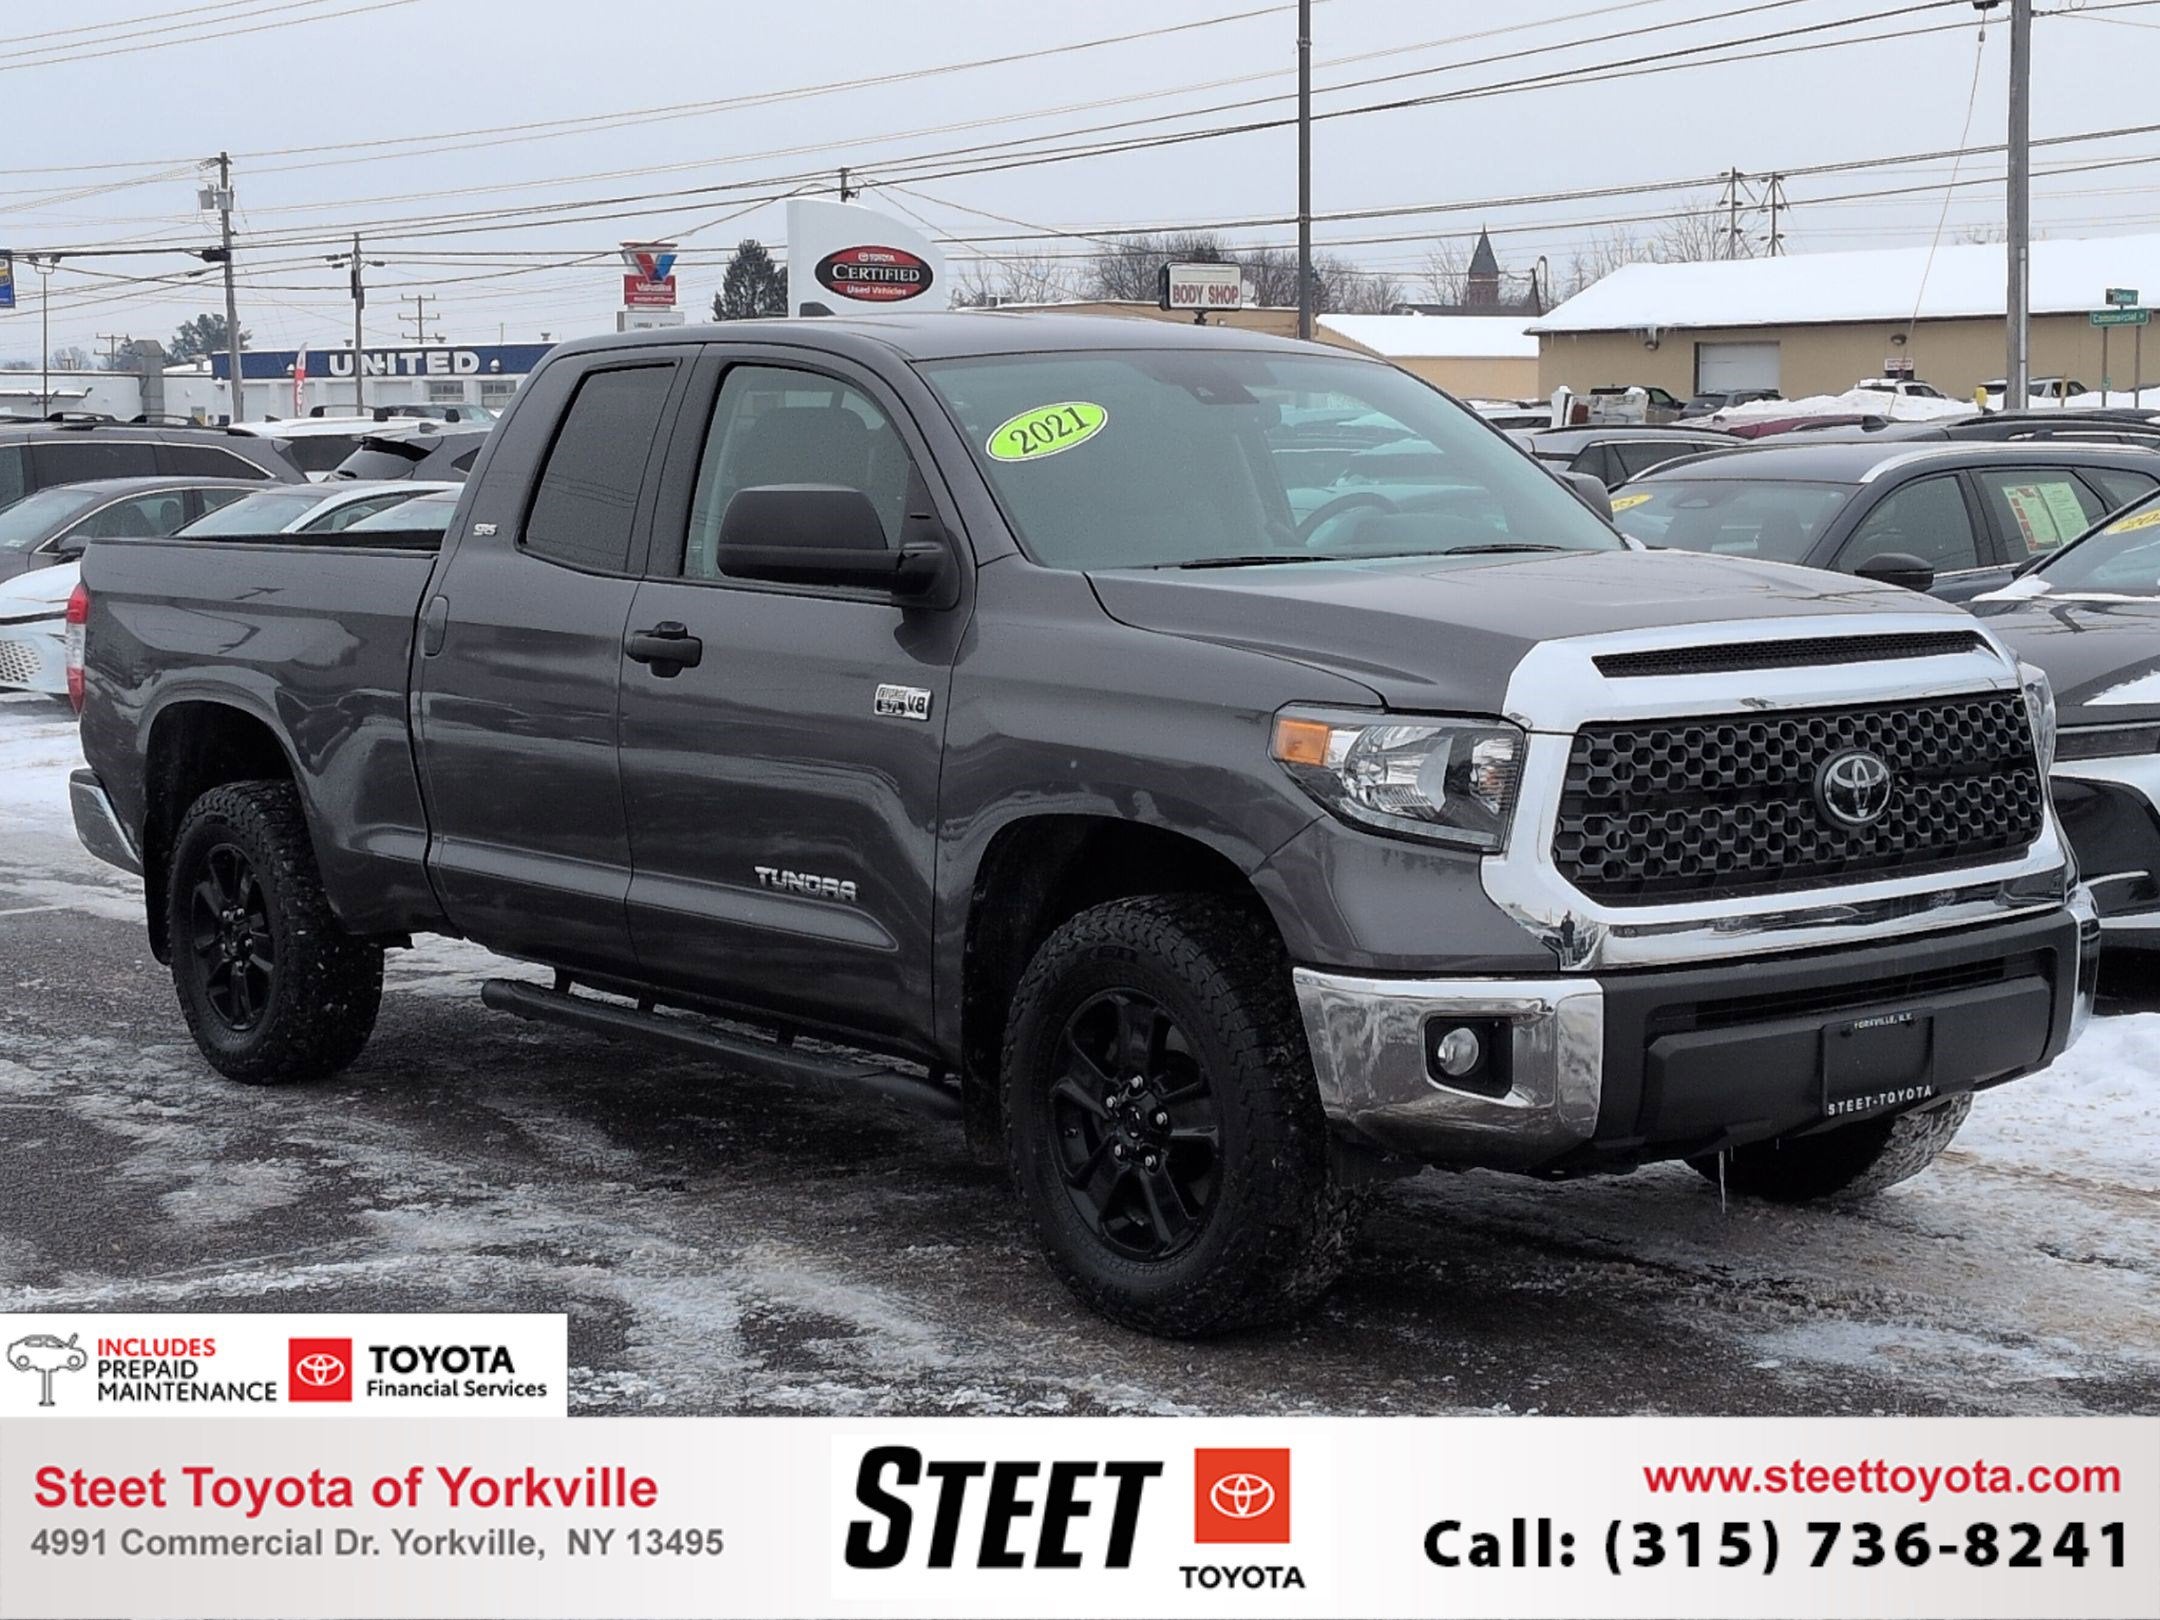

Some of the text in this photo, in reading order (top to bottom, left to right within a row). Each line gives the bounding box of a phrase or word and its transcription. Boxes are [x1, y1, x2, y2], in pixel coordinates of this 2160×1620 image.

[832, 264, 920, 282] CERTIFIED
[847, 285, 906, 295] Used Vehicles
[1172, 284, 1239, 305] BODY SHOP
[329, 351, 480, 376] UNITED
[1010, 407, 1090, 454] 2021
[754, 865, 857, 901] TUNDRA
